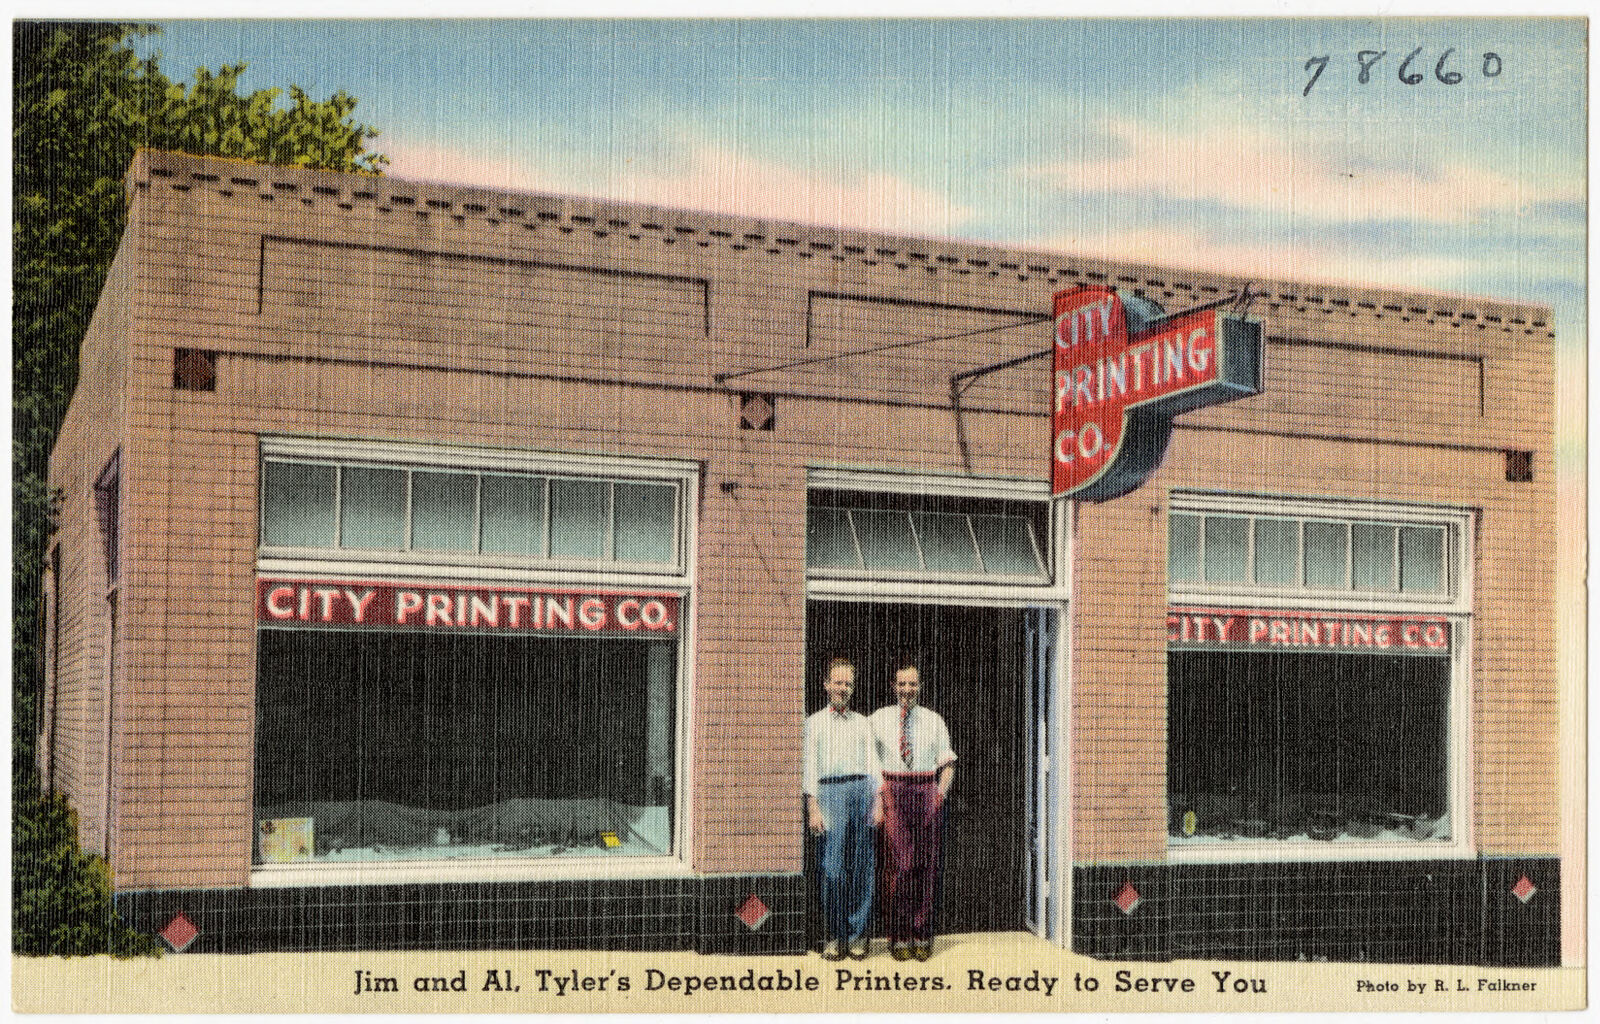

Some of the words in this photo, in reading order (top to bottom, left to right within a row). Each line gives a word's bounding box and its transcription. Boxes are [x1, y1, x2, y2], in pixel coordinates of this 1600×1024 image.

[1303, 46, 1502, 97] 78660
[1055, 294, 1114, 349] CITY
[1056, 327, 1212, 412] PRINTING
[1056, 421, 1111, 463] CO.
[266, 587, 376, 622] CITY
[397, 592, 607, 630] PRINTING
[617, 599, 673, 632] CO.
[1251, 619, 1391, 648] PRINTING
